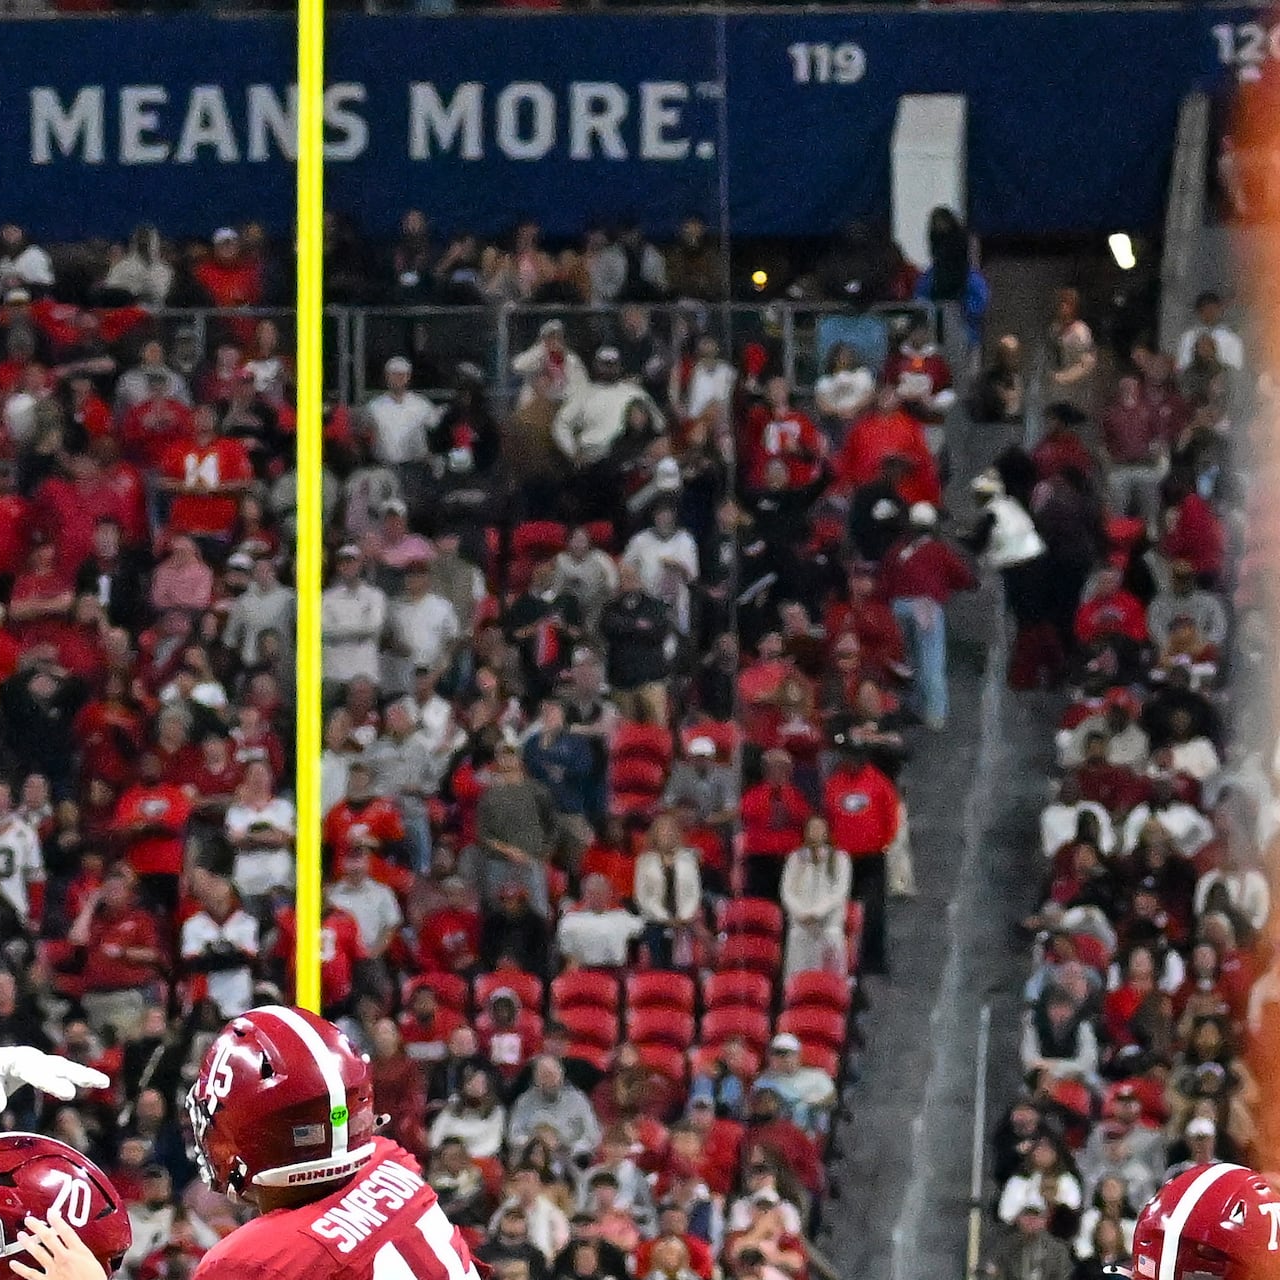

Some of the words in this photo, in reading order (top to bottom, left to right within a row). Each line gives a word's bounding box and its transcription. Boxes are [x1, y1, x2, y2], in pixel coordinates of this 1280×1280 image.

[787, 43, 867, 84] 119
[29, 86, 370, 166] MEANS
[41, 1169, 92, 1228] 70
[310, 1159, 424, 1254] SIMPSON
